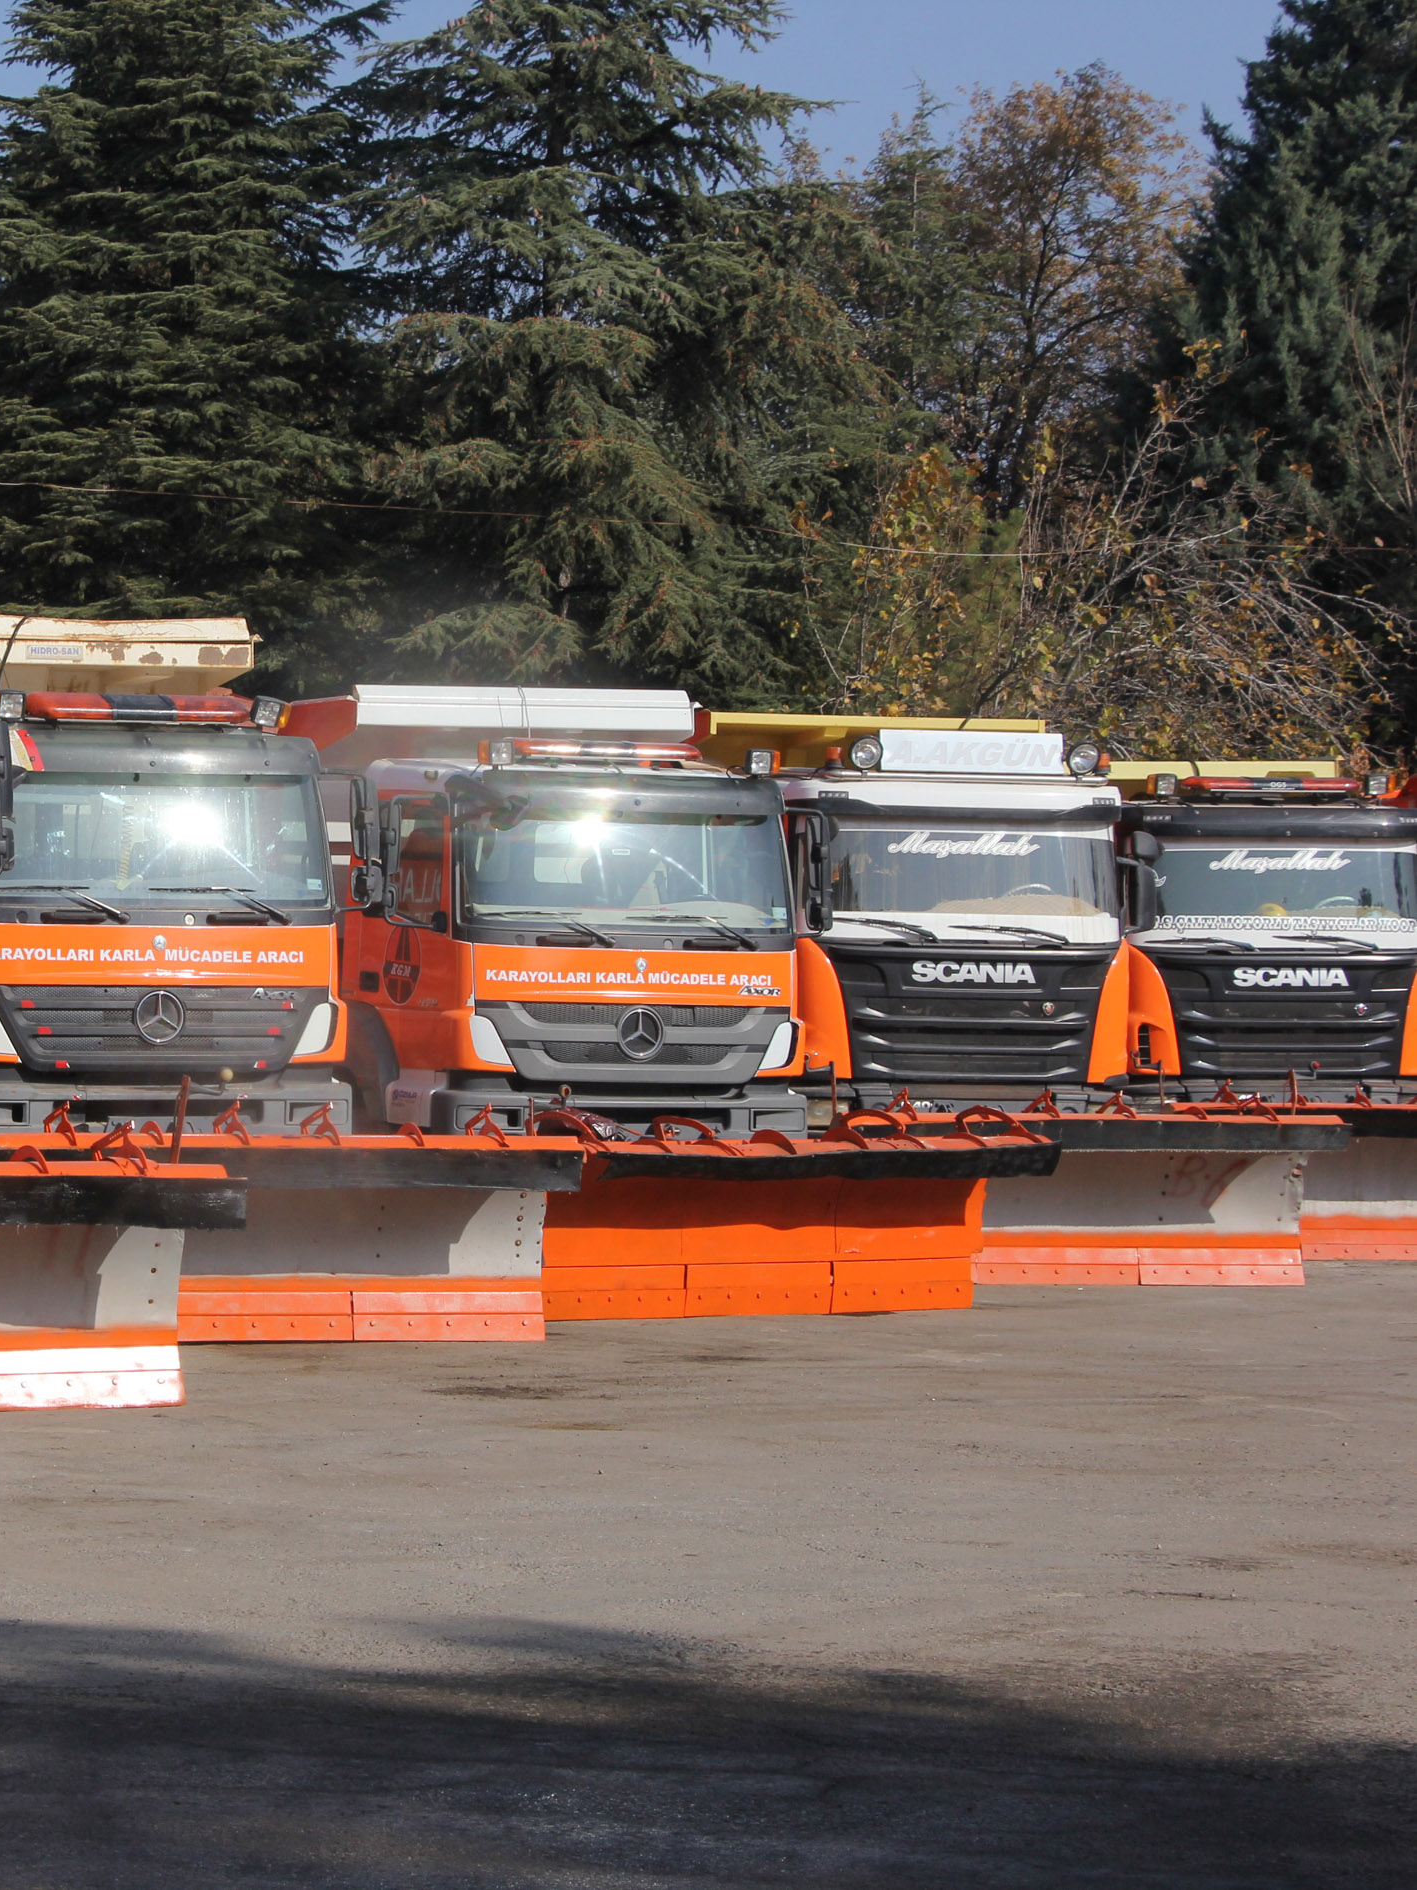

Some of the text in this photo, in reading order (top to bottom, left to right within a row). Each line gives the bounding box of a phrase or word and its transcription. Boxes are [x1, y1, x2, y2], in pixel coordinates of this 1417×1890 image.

[886, 738, 1059, 767] A.AKGÜN
[99, 949, 156, 962] KARLA
[164, 947, 252, 963] MÜCADELE
[256, 951, 304, 963] ARACI
[391, 963, 411, 977] KGM
[486, 969, 772, 986] KARAYOLLARI KARLA MÜCADELE ARACI
[911, 960, 1036, 984] SCANIA
[1233, 967, 1349, 987] SCANIA
